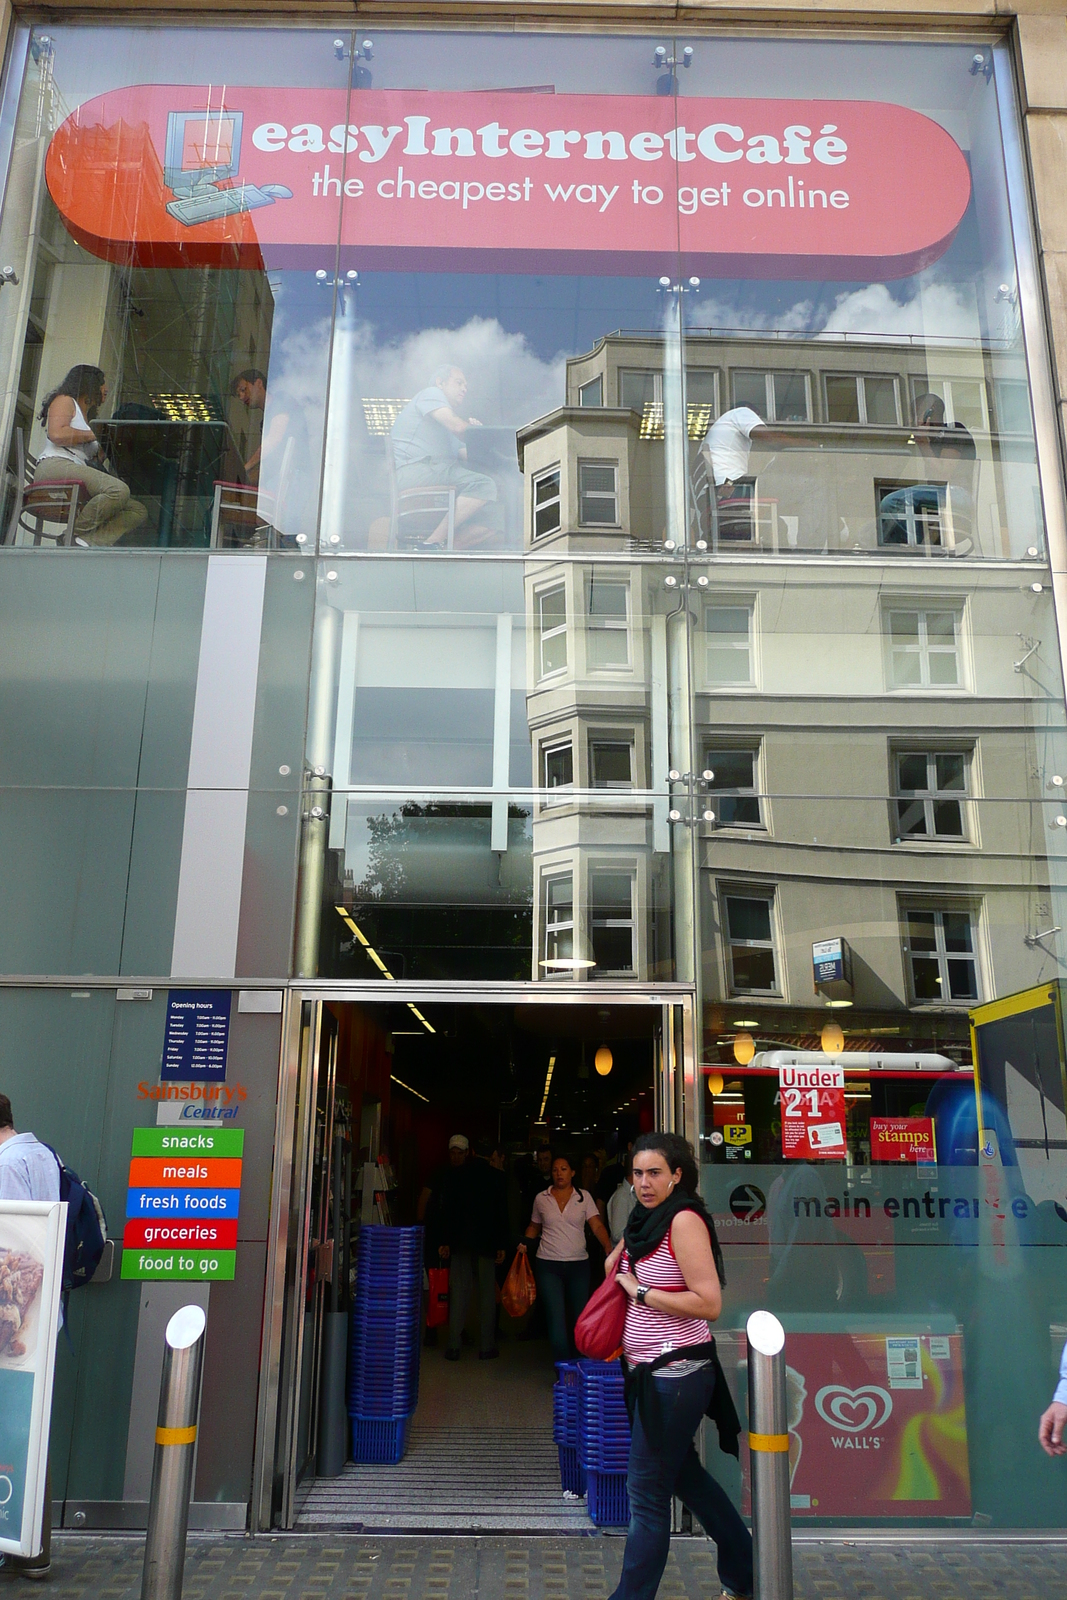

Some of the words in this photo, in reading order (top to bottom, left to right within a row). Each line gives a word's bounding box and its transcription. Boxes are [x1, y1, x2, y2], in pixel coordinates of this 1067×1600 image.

[252, 116, 848, 165] easyInternetCafé
[312, 164, 364, 196] the
[376, 167, 534, 215] cheapest
[544, 183, 619, 213] way
[632, 178, 664, 205] to
[677, 181, 730, 214] get
[743, 176, 849, 209] online
[171, 1002, 195, 1010] Opening
[783, 1068, 840, 1086] Under
[137, 1081, 247, 1105] Sainsbury's
[784, 1088, 822, 1117] 21
[183, 1105, 239, 1119] Central
[873, 1121, 888, 1133] buy
[890, 1123, 908, 1132] your
[162, 1135, 214, 1148] snacks
[878, 1130, 929, 1146] stamps
[909, 1144, 926, 1153] here
[163, 1164, 208, 1178] meals
[140, 1194, 179, 1208] fresh
[184, 1194, 227, 1209] foods
[793, 1191, 871, 1218] main
[144, 1225, 218, 1242] groceries
[138, 1255, 173, 1270] food
[178, 1256, 194, 1270] to
[199, 1259, 219, 1273] go
[831, 1436, 881, 1449] WALL'S
